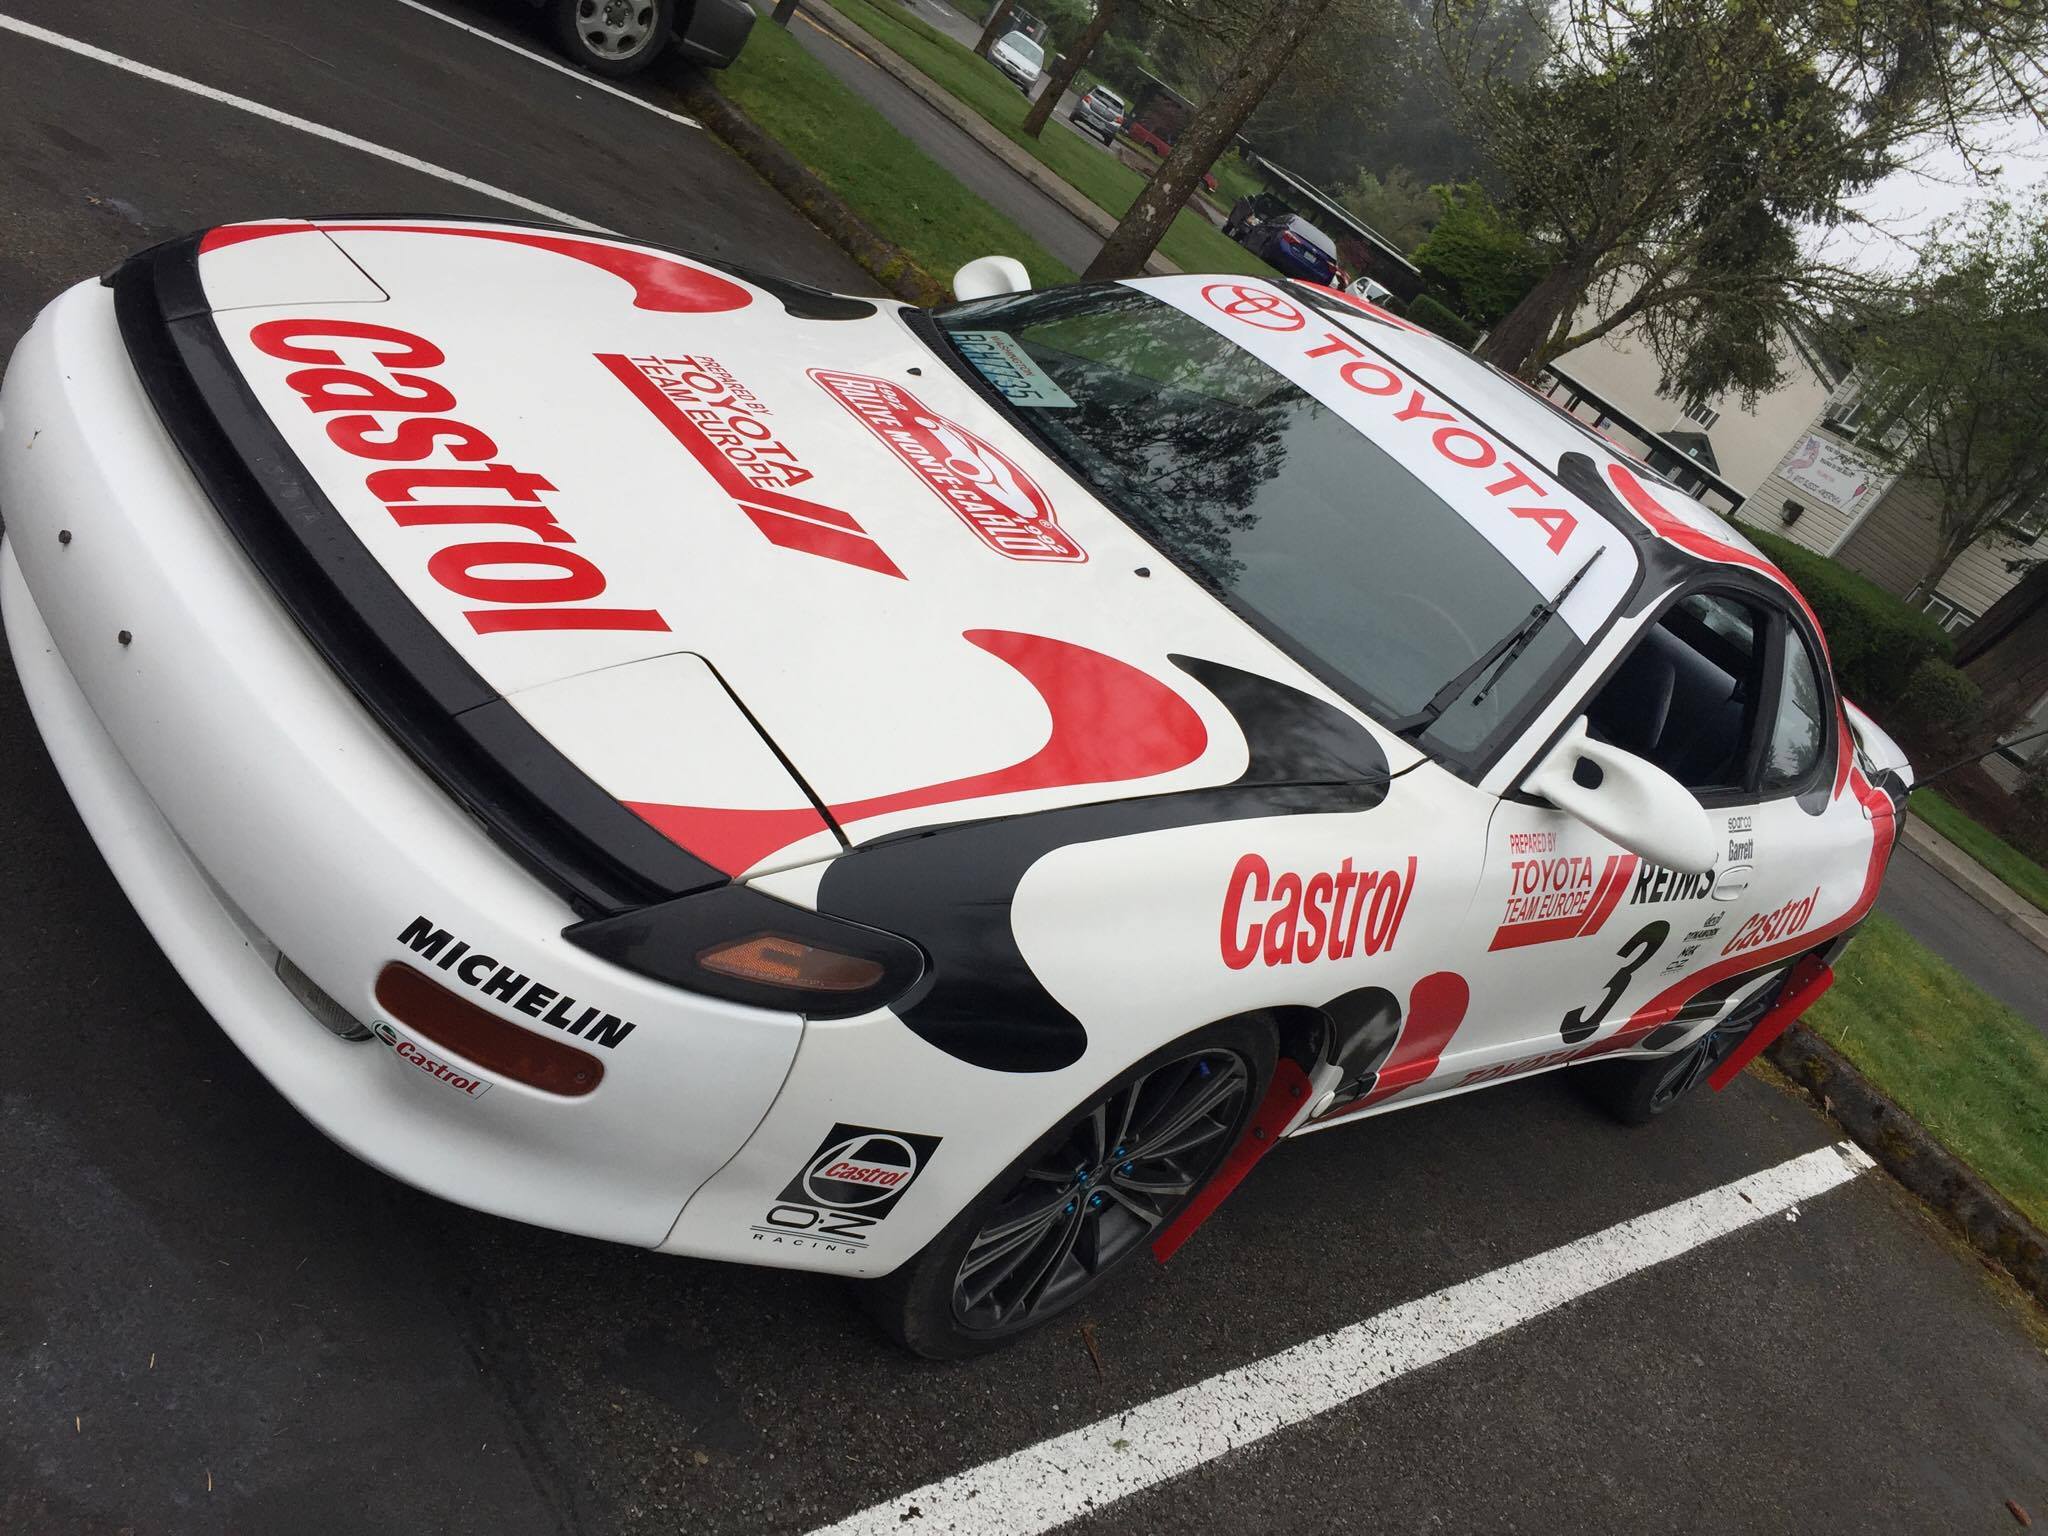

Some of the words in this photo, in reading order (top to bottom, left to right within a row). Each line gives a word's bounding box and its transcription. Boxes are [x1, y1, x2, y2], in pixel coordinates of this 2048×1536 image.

[694, 355, 756, 400] PREPARED
[746, 402, 775, 416] BY
[878, 381, 908, 411] 1992
[631, 355, 701, 402] TEAM
[685, 409, 786, 488] EUROPE
[663, 354, 814, 487] TOYOTA
[1304, 333, 1579, 556] TOYOTA
[250, 319, 672, 635] Castrol
[823, 376, 897, 428] RALLYE
[887, 429, 1046, 552] MONTE-CARLO
[1011, 516, 1068, 554] 1992
[1510, 832, 1546, 854] PREPARED
[1547, 832, 1556, 852] BY
[1728, 838, 1753, 861] Garrett
[1511, 857, 1592, 895] TOYOTA
[1630, 859, 1716, 905] REIMS
[1220, 853, 1418, 970] Castrol
[1503, 898, 1537, 923] TEAM
[1538, 891, 1590, 919] EUROPE
[1721, 886, 1820, 956] Castrol
[397, 915, 637, 1049] MICHELIN
[1559, 920, 1670, 1044] 3
[396, 1042, 480, 1094] Castrol
[825, 1162, 909, 1186] Castrol
[753, 1233, 857, 1254] RACING
